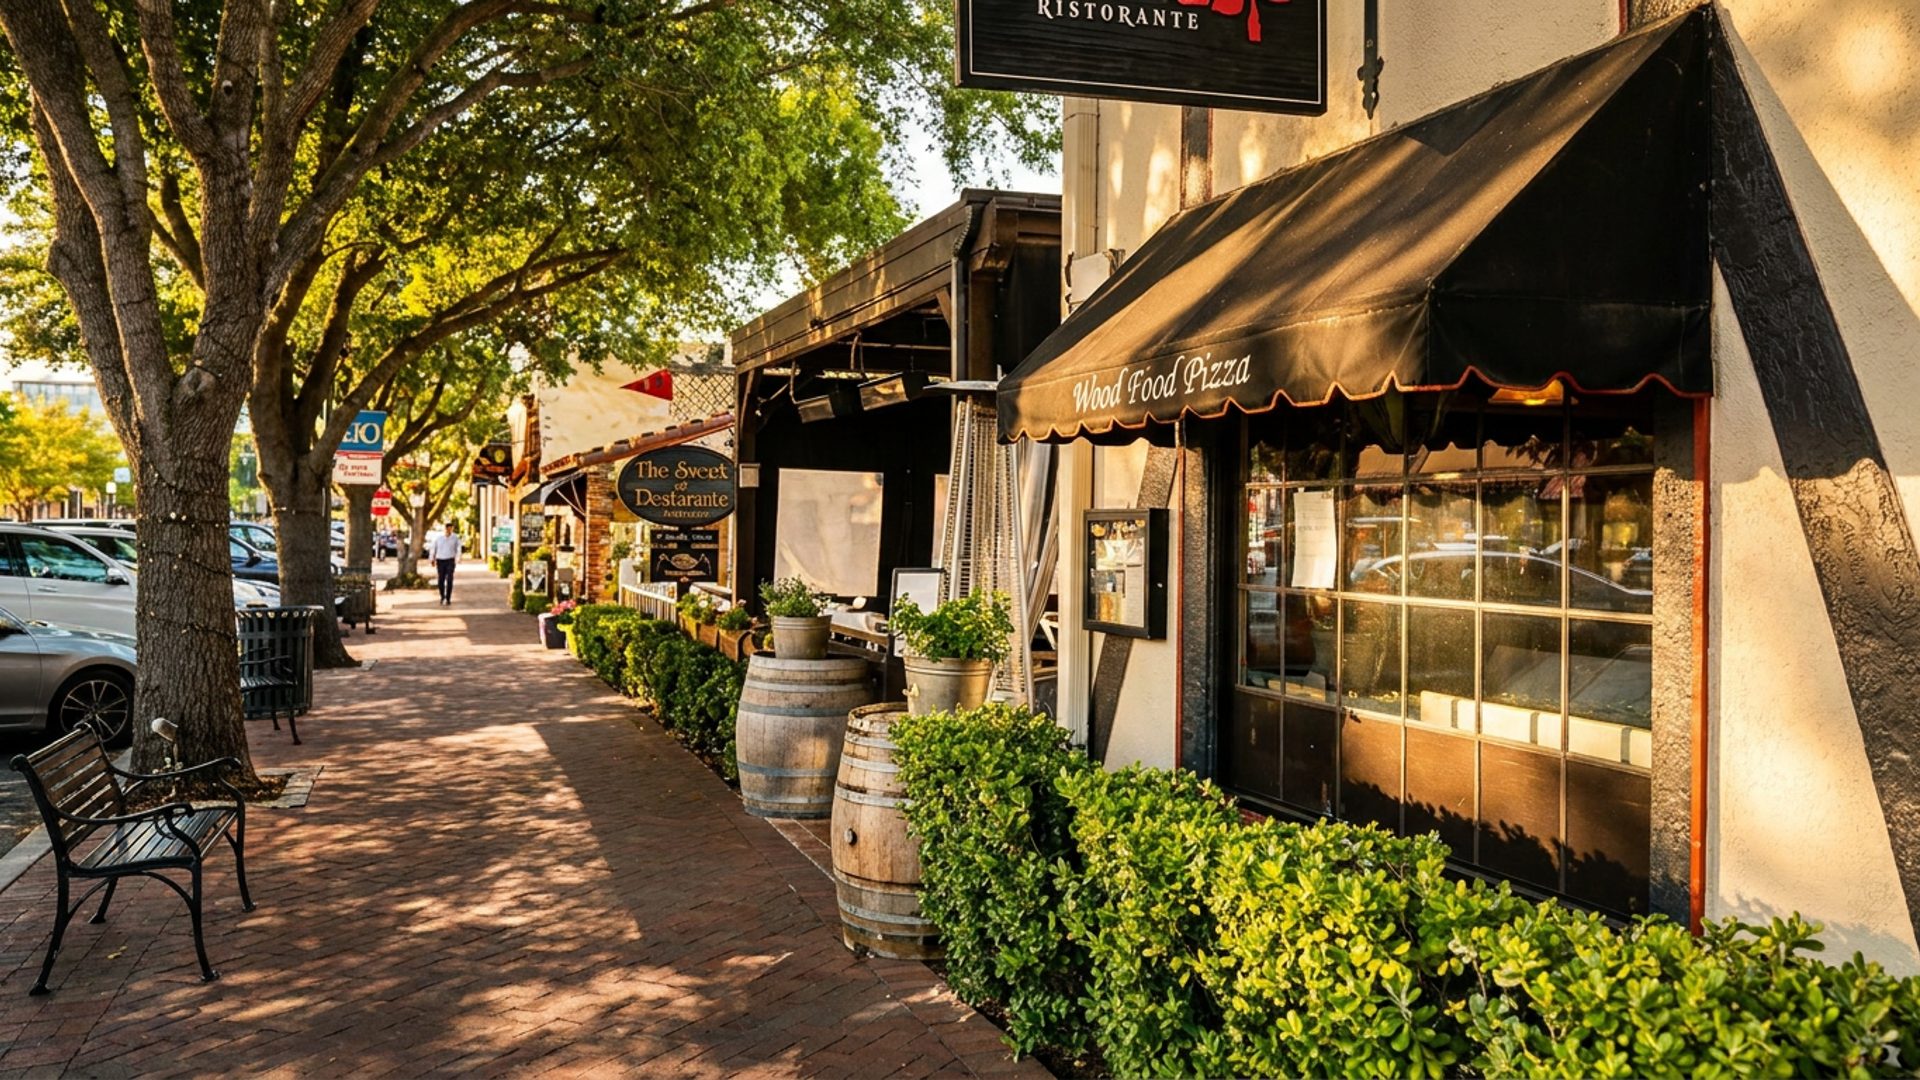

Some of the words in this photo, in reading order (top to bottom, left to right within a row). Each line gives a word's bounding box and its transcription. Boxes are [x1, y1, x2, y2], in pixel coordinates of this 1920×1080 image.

[1037, 0, 1199, 30] RISTORANTE
[1073, 367, 1128, 413] Wood
[1128, 355, 1185, 405] Food
[1184, 353, 1251, 395] Pizza
[635, 461, 669, 479] The
[635, 488, 729, 508] Destarante
